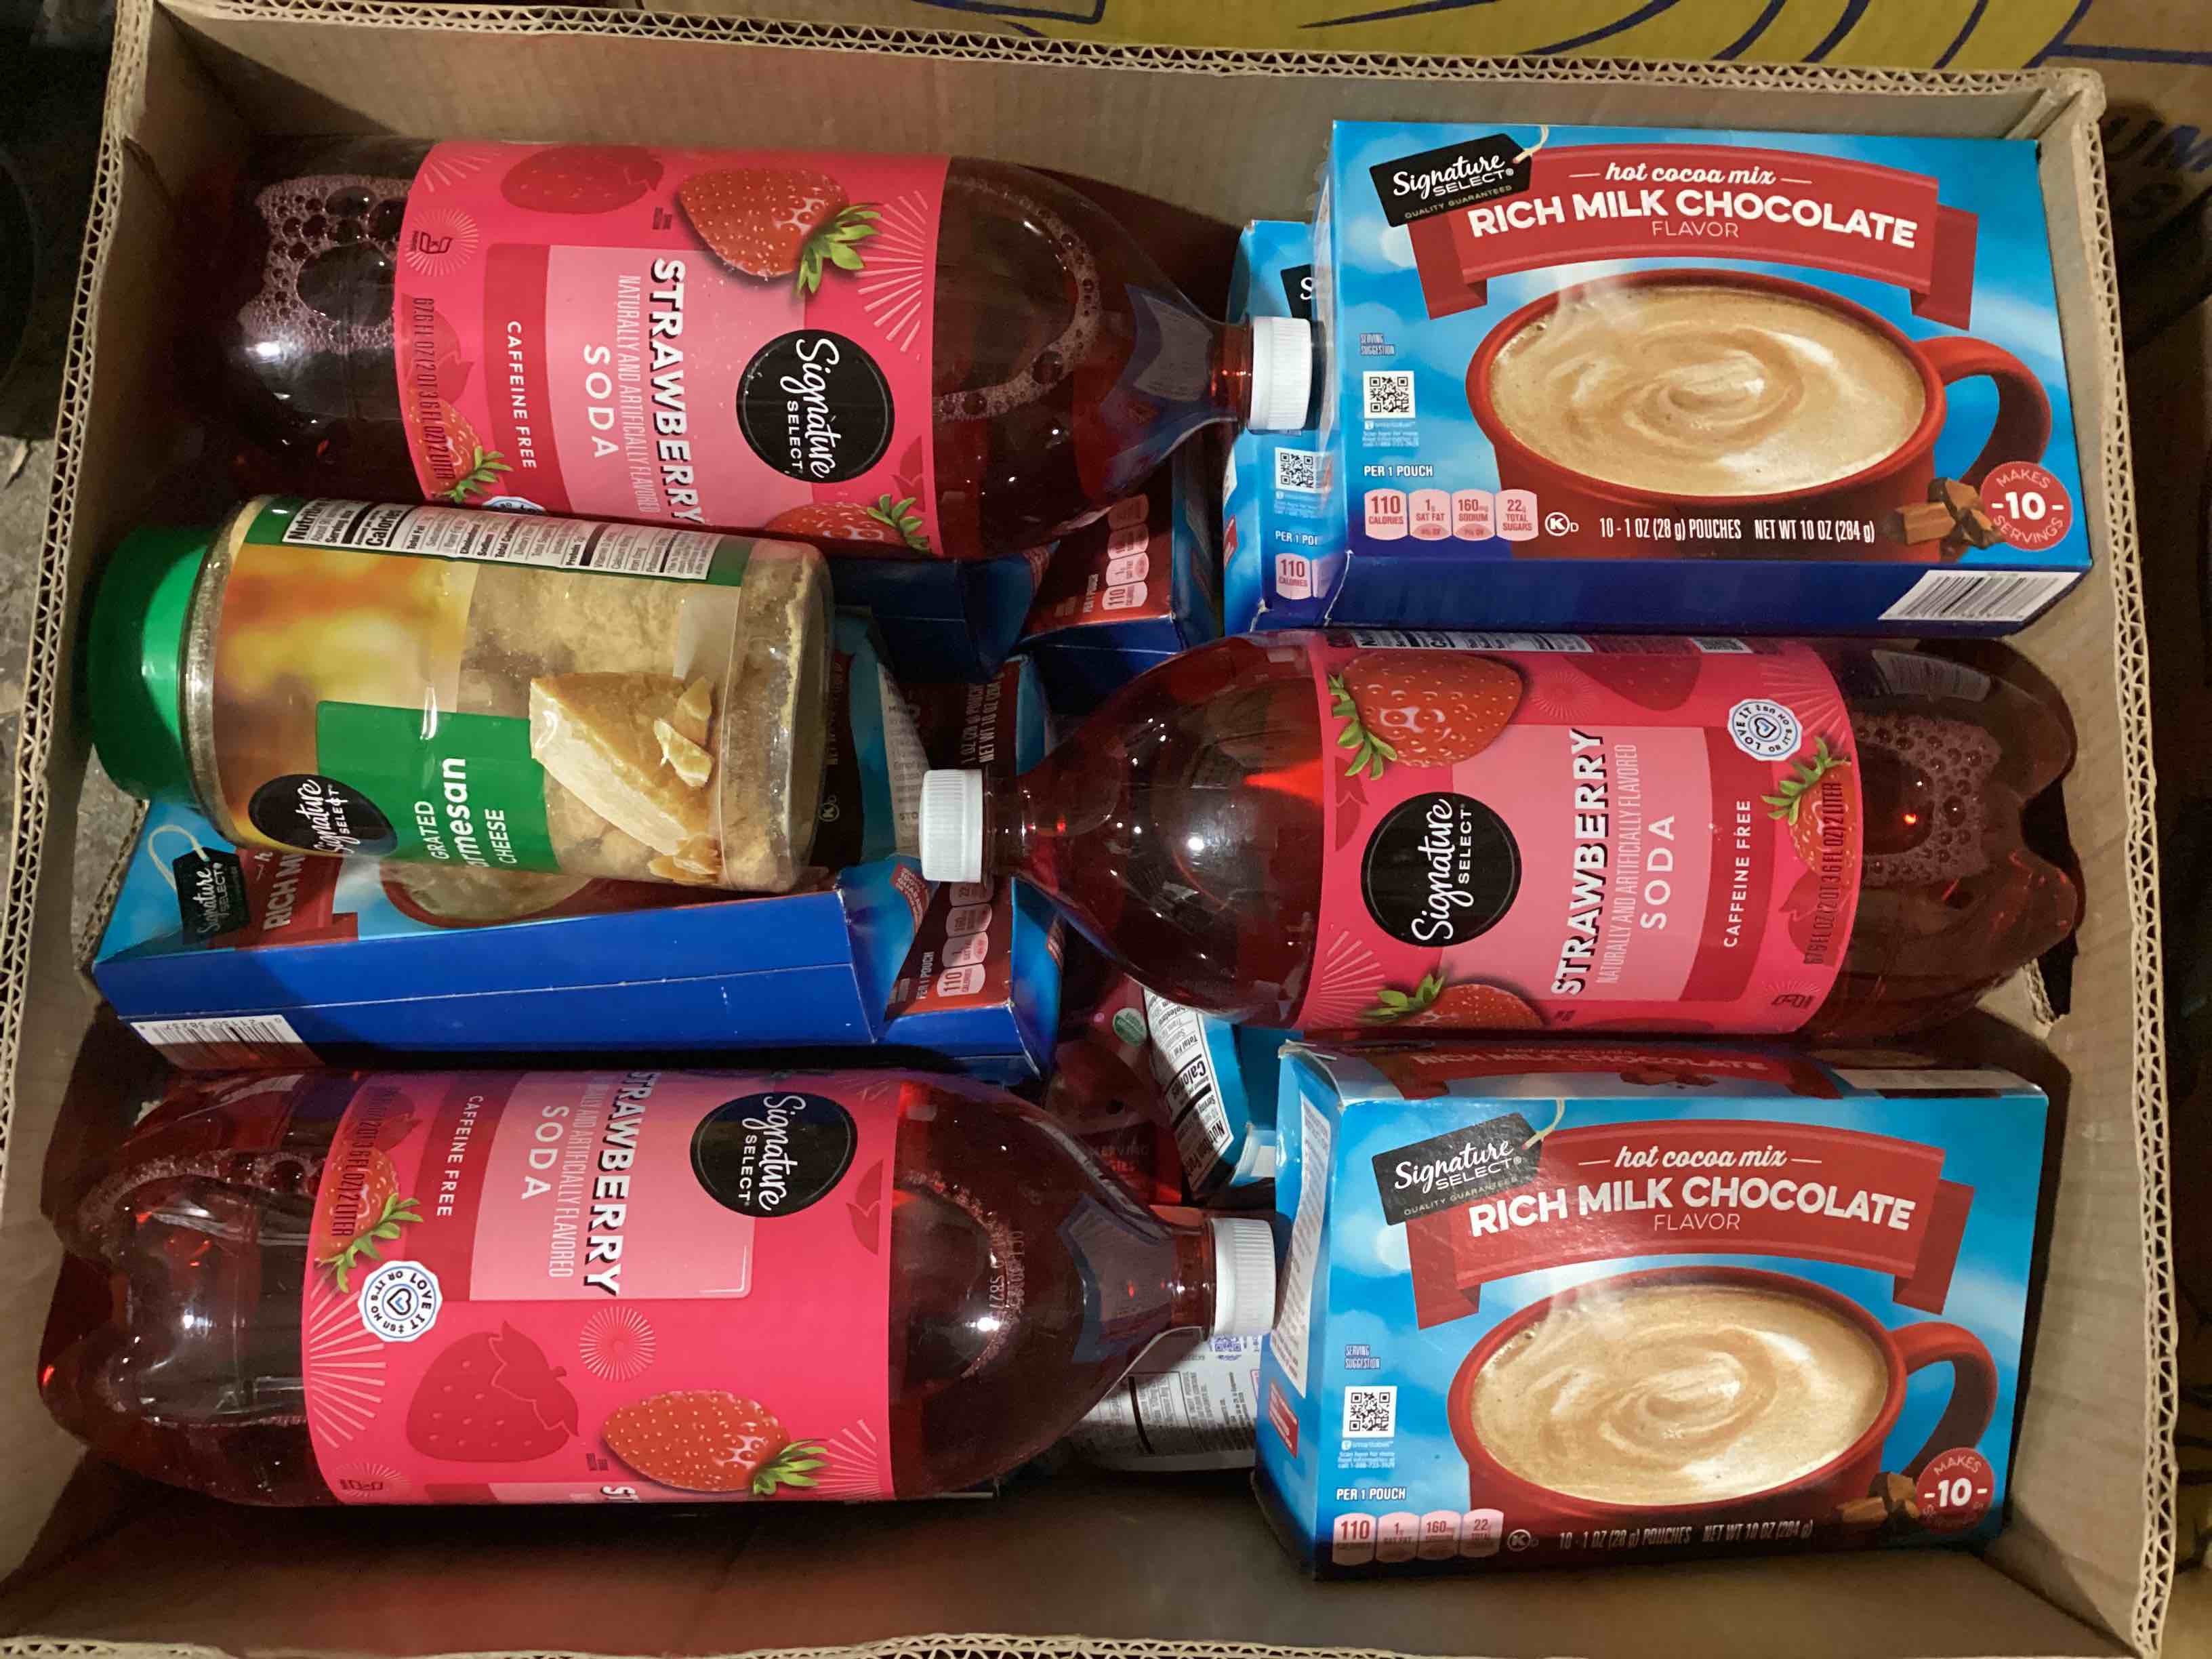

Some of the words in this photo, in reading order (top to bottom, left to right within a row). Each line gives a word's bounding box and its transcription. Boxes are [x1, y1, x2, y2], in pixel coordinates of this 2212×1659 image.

[1393, 151, 1506, 200] Signature
[1604, 162, 1648, 181] hot
[1652, 167, 1725, 184] cocoa
[1727, 165, 1776, 186] mix
[1404, 201, 1445, 220] QUALITY
[1448, 184, 1513, 209] GUARANTEED
[1467, 197, 1565, 238] RICH
[1575, 189, 1666, 220] MILK
[1675, 188, 1918, 249] CHOCOLATE
[1652, 221, 1739, 238] FLAVOR
[616, 274, 642, 351] NATURALLY
[506, 321, 529, 420] CAFFEINE
[617, 353, 642, 382] AND
[583, 344, 619, 459] SODA
[649, 257, 705, 525] STRAWBERRY
[779, 338, 841, 480] Signature
[415, 341, 435, 356] OZ
[429, 453, 456, 480] LITER
[618, 384, 651, 465] ARTIFICIALLY
[515, 425, 537, 469] FREE
[1364, 465, 1385, 477] PER
[1388, 466, 1393, 477] 1
[1396, 465, 1433, 477] POUCH
[1996, 468, 2051, 489] MAKES
[1368, 516, 1404, 525] CALORIES
[1371, 495, 1400, 514] 110
[1416, 513, 1430, 521] SAT
[1431, 513, 1445, 521] FAT
[1458, 513, 1488, 522] SODIUM
[1506, 514, 1527, 522] TOTAL
[365, 508, 403, 547] Calories
[1275, 530, 1293, 543] PER
[1502, 523, 1532, 532] SUGARS
[1600, 518, 1613, 537] 10
[1625, 518, 1630, 539] 1
[1635, 518, 1651, 539] OZ
[1654, 518, 1671, 540] (28
[1674, 519, 1686, 541] g)
[1689, 518, 1741, 540] POUCHES
[1755, 518, 1776, 540] NET
[1778, 519, 1797, 540] WT
[1800, 519, 1815, 540] 10
[1816, 519, 1832, 541] OZ
[1835, 519, 1861, 541] (284
[1864, 521, 1875, 544] g)
[1993, 515, 2064, 544] SERVINGS
[493, 543, 510, 558] Total
[1279, 558, 1305, 577] 110
[1739, 707, 1752, 719] IT
[1736, 722, 1761, 750] LOVE
[1614, 744, 1641, 810] FLAVORED
[442, 758, 491, 869] armesan
[1821, 781, 1844, 815] LITER
[414, 801, 449, 859] GRATED
[484, 808, 518, 863] CHEESE
[1736, 800, 1750, 849] FREE
[1412, 798, 1475, 942] Signature
[1550, 727, 1610, 996] STRAWBERRY
[1616, 810, 1642, 895] ARTIFICIALLY
[1640, 815, 1675, 930] SODA
[194, 867, 222, 934] Signature
[263, 883, 299, 931] RICH
[1612, 895, 1636, 922] AND
[1723, 857, 1750, 948] CAFFEINE
[920, 951, 935, 977] POUCH
[1595, 922, 1630, 984] NATURALLY
[943, 972, 962, 991] 110
[1170, 1060, 1207, 1101] Calories
[1561, 1052, 1768, 1073] CHOCOLATE
[447, 1095, 485, 1164] CAFFEINE
[520, 1105, 570, 1200] SODA
[556, 1130, 594, 1205] ARTIFICIALLY
[742, 1094, 806, 1211] Signature
[1393, 1140, 1515, 1194] Signature
[1614, 1145, 1659, 1168] hot
[1662, 1149, 1736, 1168] cocoa
[1737, 1145, 1787, 1168] mix
[436, 1169, 459, 1216] FREE
[1404, 1195, 1446, 1216] QUALITY
[1449, 1176, 1519, 1202] GUARANTEED
[1469, 1187, 1568, 1237] RICH
[1578, 1176, 1674, 1216] MILK
[1681, 1176, 1917, 1231] CHOCOLATE
[331, 1203, 359, 1237] LITER
[1654, 1212, 1741, 1231] FLAVOR
[548, 1207, 580, 1277] FLAVORED
[370, 1279, 386, 1300] IT'S
[387, 1271, 403, 1280] OR
[409, 1273, 432, 1310] LOVE
[371, 1306, 383, 1322] ON
[409, 1313, 425, 1330] IT
[1933, 1455, 1982, 1475] MAKES
[1336, 1489, 1357, 1501] PER
[1369, 1488, 1406, 1500] POUCH
[1340, 1520, 1370, 1540] 110
[1559, 1532, 1572, 1551] 10
[1592, 1530, 1606, 1549] OZ
[1642, 1526, 1692, 1547] POUCHES
[1702, 1523, 1723, 1544] NET
[1726, 1523, 1743, 1542] WT
[1745, 1523, 1759, 1541] 10
[1761, 1521, 1776, 1540] OZ
